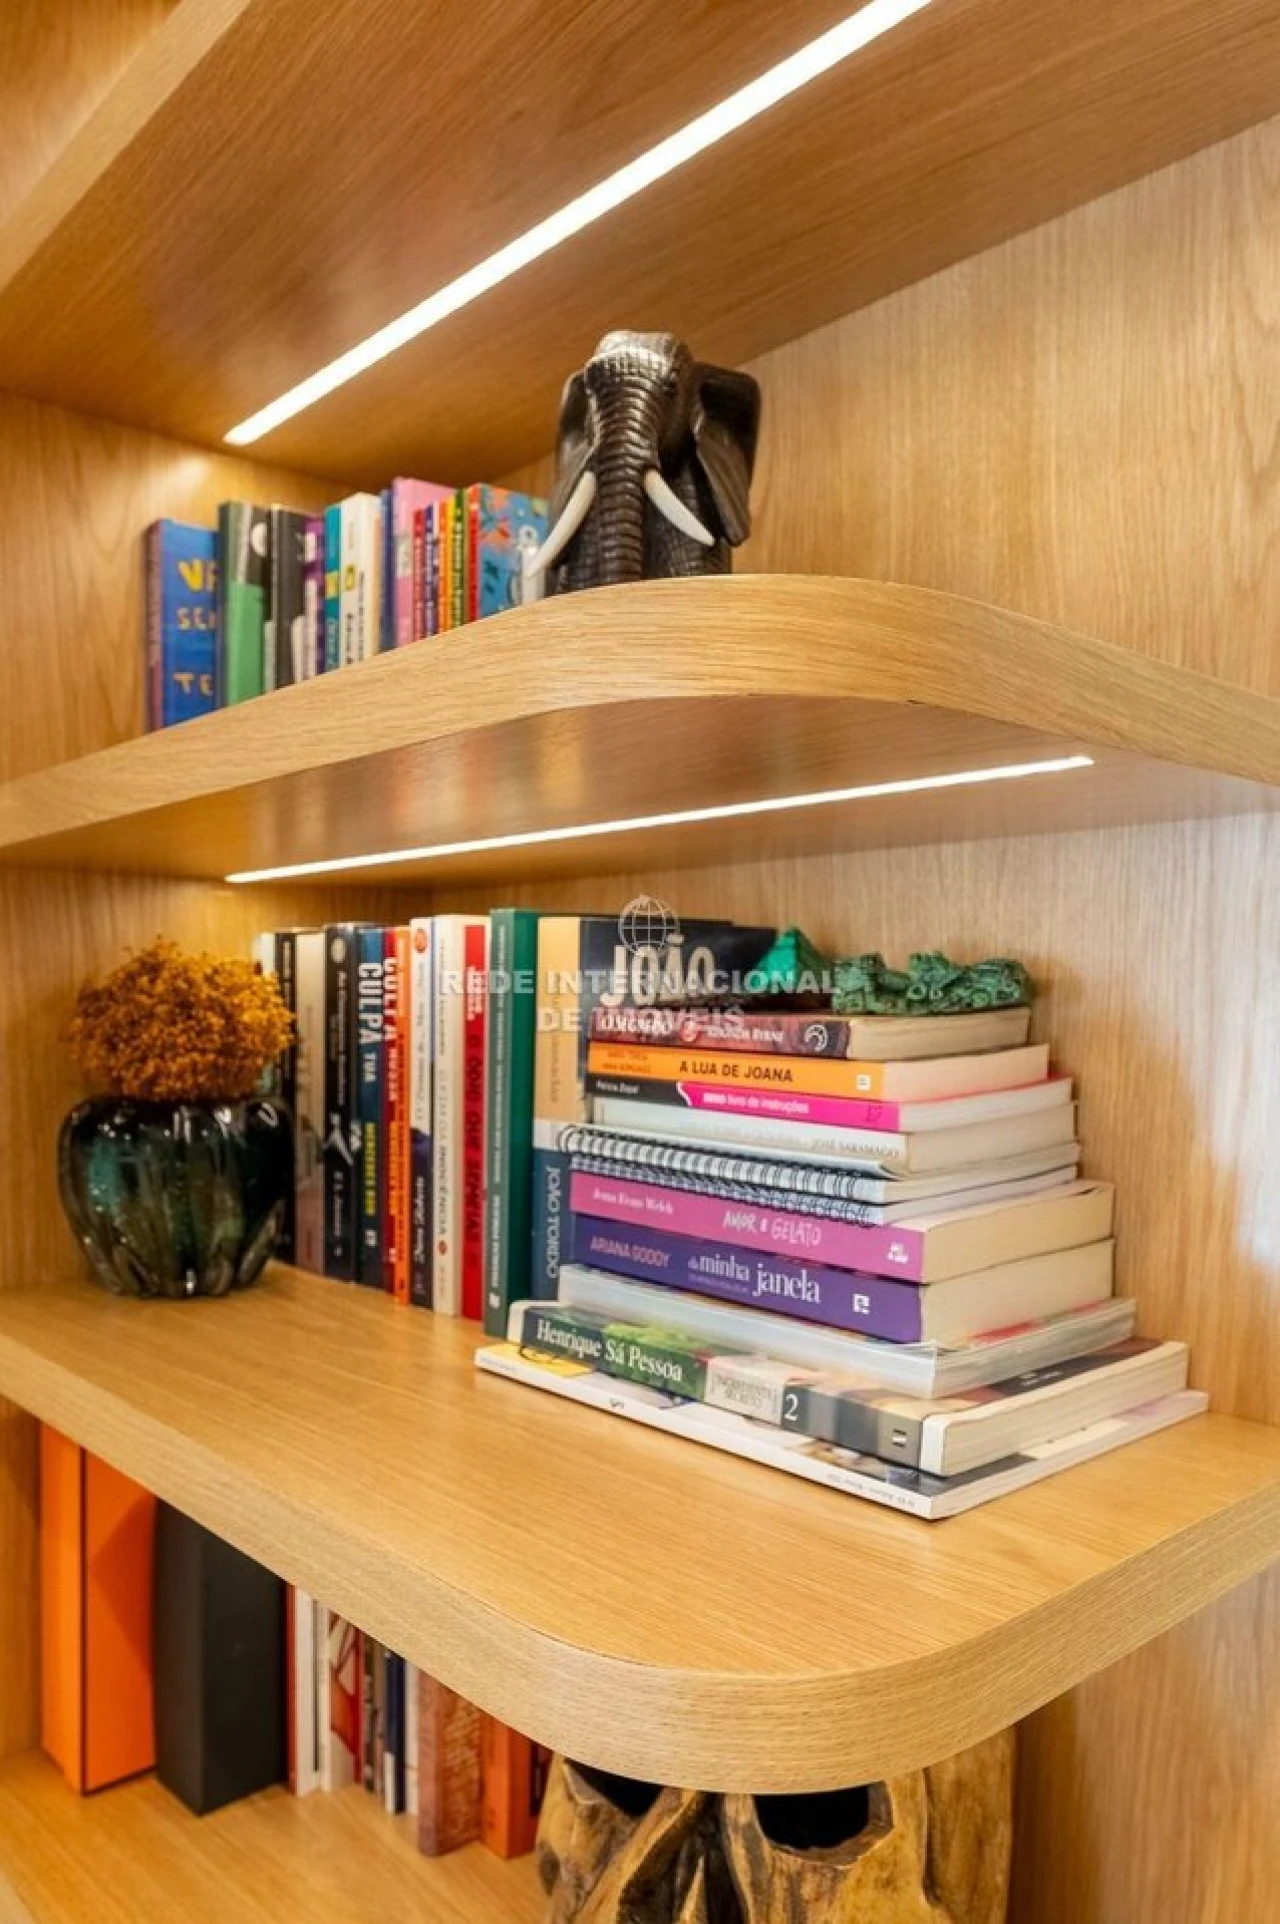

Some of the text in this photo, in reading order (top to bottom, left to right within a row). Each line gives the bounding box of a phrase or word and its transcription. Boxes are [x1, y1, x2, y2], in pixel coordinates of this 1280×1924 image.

[600, 933, 716, 1007] JOÃO
[359, 962, 383, 1044] CULPA
[679, 1060, 793, 1082] A LUA DE JOANA
[546, 1165, 562, 1279] JOÃO TORDO
[722, 1210, 757, 1233] AMOR
[771, 1217, 822, 1247] GELATO
[590, 1236, 631, 1260] ARIANA
[700, 1253, 749, 1282] minha
[752, 1263, 820, 1304] janela
[537, 1318, 683, 1382] Henrique Sá Pessoa
[784, 1393, 799, 1421] 2
